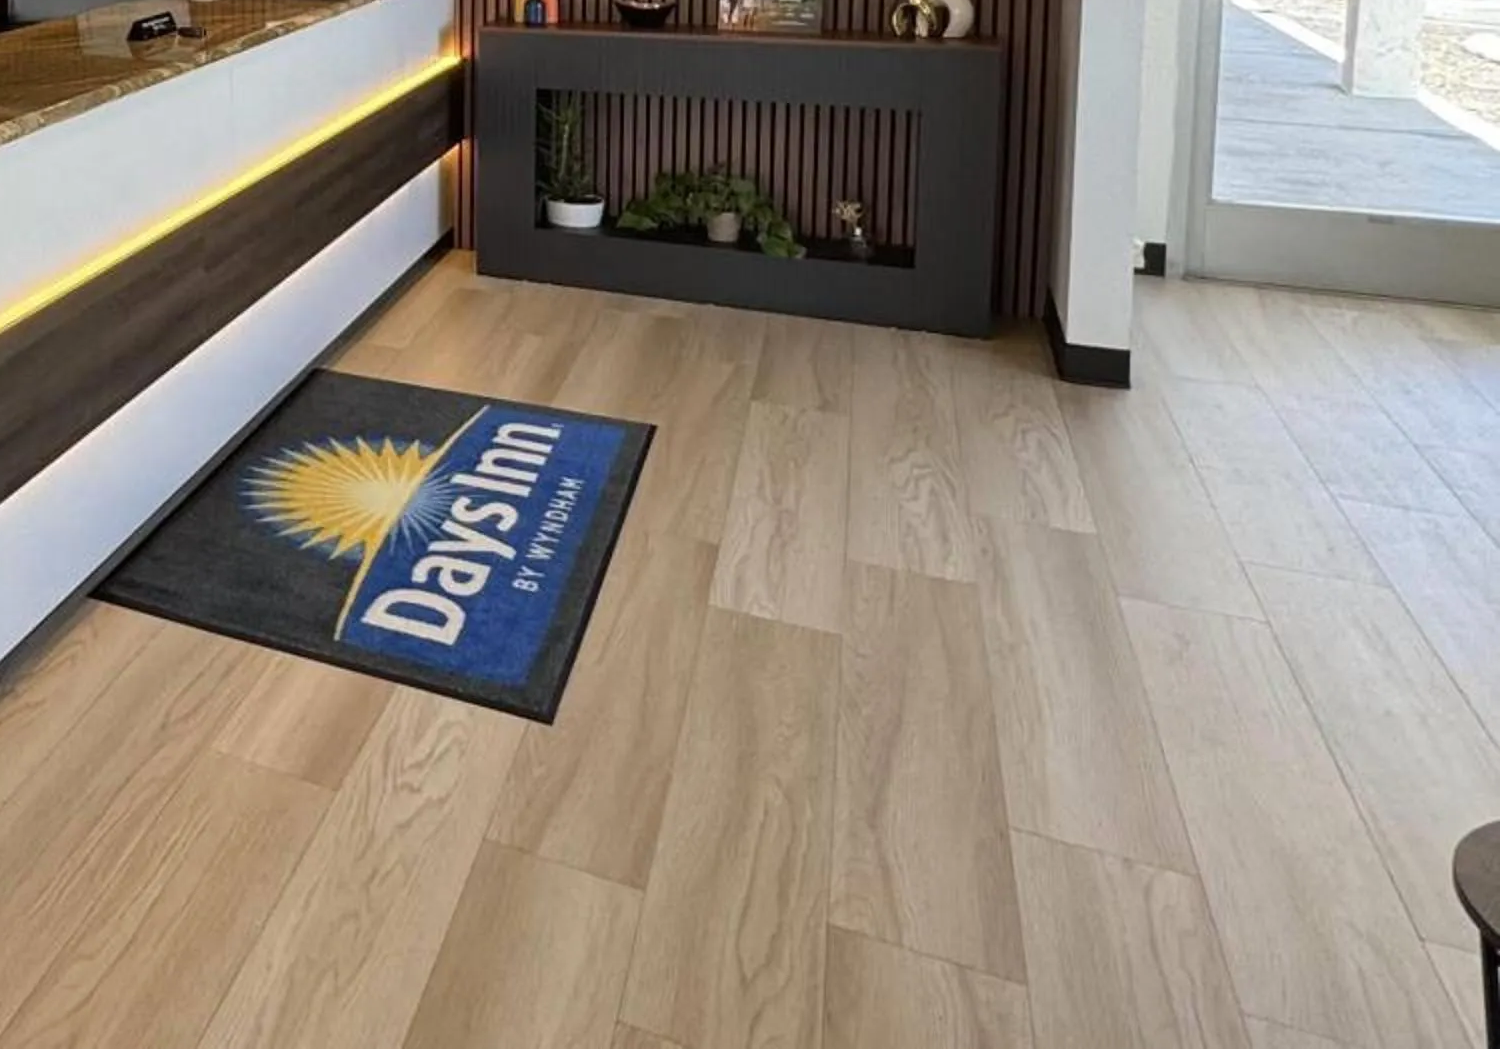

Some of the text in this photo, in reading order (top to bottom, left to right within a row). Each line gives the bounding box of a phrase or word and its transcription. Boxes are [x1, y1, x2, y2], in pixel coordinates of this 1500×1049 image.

[362, 424, 561, 645] Days Inn
[513, 478, 584, 592] BY WYNDHAM
